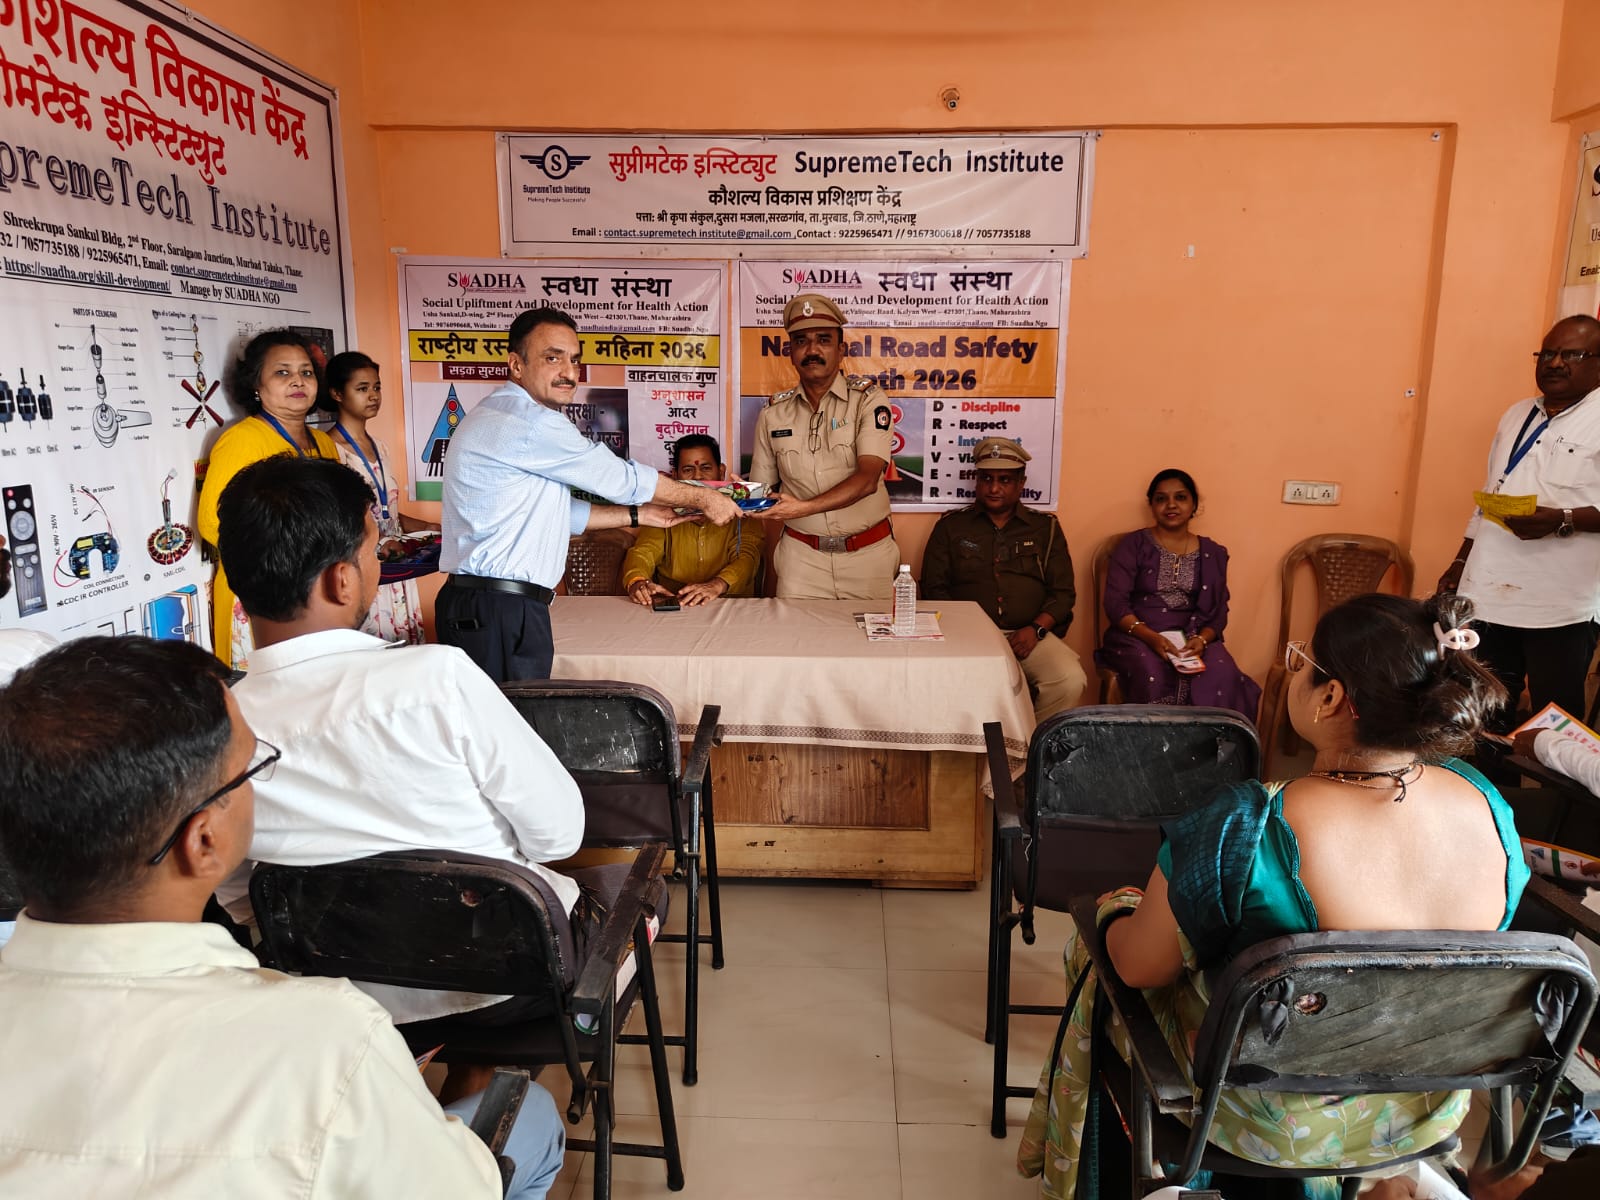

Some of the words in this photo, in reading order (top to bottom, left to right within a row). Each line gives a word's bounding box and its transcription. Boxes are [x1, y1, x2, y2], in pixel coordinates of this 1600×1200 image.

[0, 45, 92, 131] ीमटेक
[145, 24, 256, 136] विकास
[262, 76, 309, 160] केंद्र
[608, 145, 689, 182] सुप्रीमटेक
[794, 149, 952, 177] SupremeTech
[966, 149, 1064, 173] Institute
[523, 184, 563, 194] SupremeTech
[564, 185, 591, 194] Institute
[708, 184, 761, 206] कौशल्य
[765, 186, 813, 206] विकास
[817, 186, 873, 207] प्रशिक्षण
[877, 184, 902, 207] केंद्र
[0, 141, 196, 225] premeTech
[208, 184, 331, 255] Institute
[636, 212, 655, 222] पत्ता:
[657, 210, 668, 223] श्री
[670, 212, 687, 225] कृपा
[3, 210, 65, 237] Shreekrupa
[67, 224, 100, 242] Sankul
[101, 230, 126, 248] Bldg,
[141, 238, 167, 255] Floor,
[167, 243, 202, 260] Saralgaon
[204, 250, 235, 267] Junction,
[236, 256, 261, 271] Murbad
[572, 228, 596, 237] Email
[604, 229, 697, 238] contact.supremetech
[700, 229, 792, 239] institute@gmail.com
[839, 229, 893, 238] 9225965471
[907, 229, 962, 238] 9167300618
[976, 229, 1031, 238] 7057735188
[22, 236, 80, 258] 7057735188
[88, 247, 141, 269] 9225965471,
[143, 256, 168, 271] Email:
[541, 276, 599, 296] स्वधा
[611, 270, 672, 298] संस्था
[878, 271, 937, 292] स्वधा
[950, 265, 1013, 292] संस्था
[180, 280, 211, 298] Manage
[212, 284, 222, 300] by
[225, 287, 261, 302] SUADHA
[263, 293, 280, 304] NGO
[755, 294, 787, 305] Social
[850, 296, 873, 305] And
[877, 294, 952, 307] Development
[956, 294, 972, 305] for
[975, 295, 1012, 305] Health
[1013, 296, 1049, 305] Action
[422, 298, 453, 308] Social
[456, 298, 512, 310] Upliftment
[515, 299, 537, 309] And
[540, 299, 614, 312] Development
[617, 301, 633, 311] for
[636, 301, 671, 311] Health
[674, 302, 708, 312] Action
[418, 332, 478, 359] राष्ट्रीय
[595, 335, 654, 360] महिना
[880, 335, 946, 358] Road
[955, 334, 1038, 364] Safety
[478, 366, 508, 378] सुरक्षा
[628, 370, 693, 382] वाहनचालक
[696, 370, 717, 387] गुण
[913, 369, 976, 391] 2026
[651, 389, 706, 406] अनुशासन
[668, 407, 697, 418] आदर
[933, 401, 944, 412] D
[961, 402, 1021, 414] Discipline
[932, 418, 942, 429] R
[959, 420, 1007, 432] Respect
[932, 435, 936, 446] I
[931, 452, 941, 463] V
[958, 453, 976, 463] Vis
[930, 469, 938, 479] E
[959, 470, 977, 480] Eff
[930, 487, 939, 497] R
[88, 580, 129, 598] CONTROLLER
